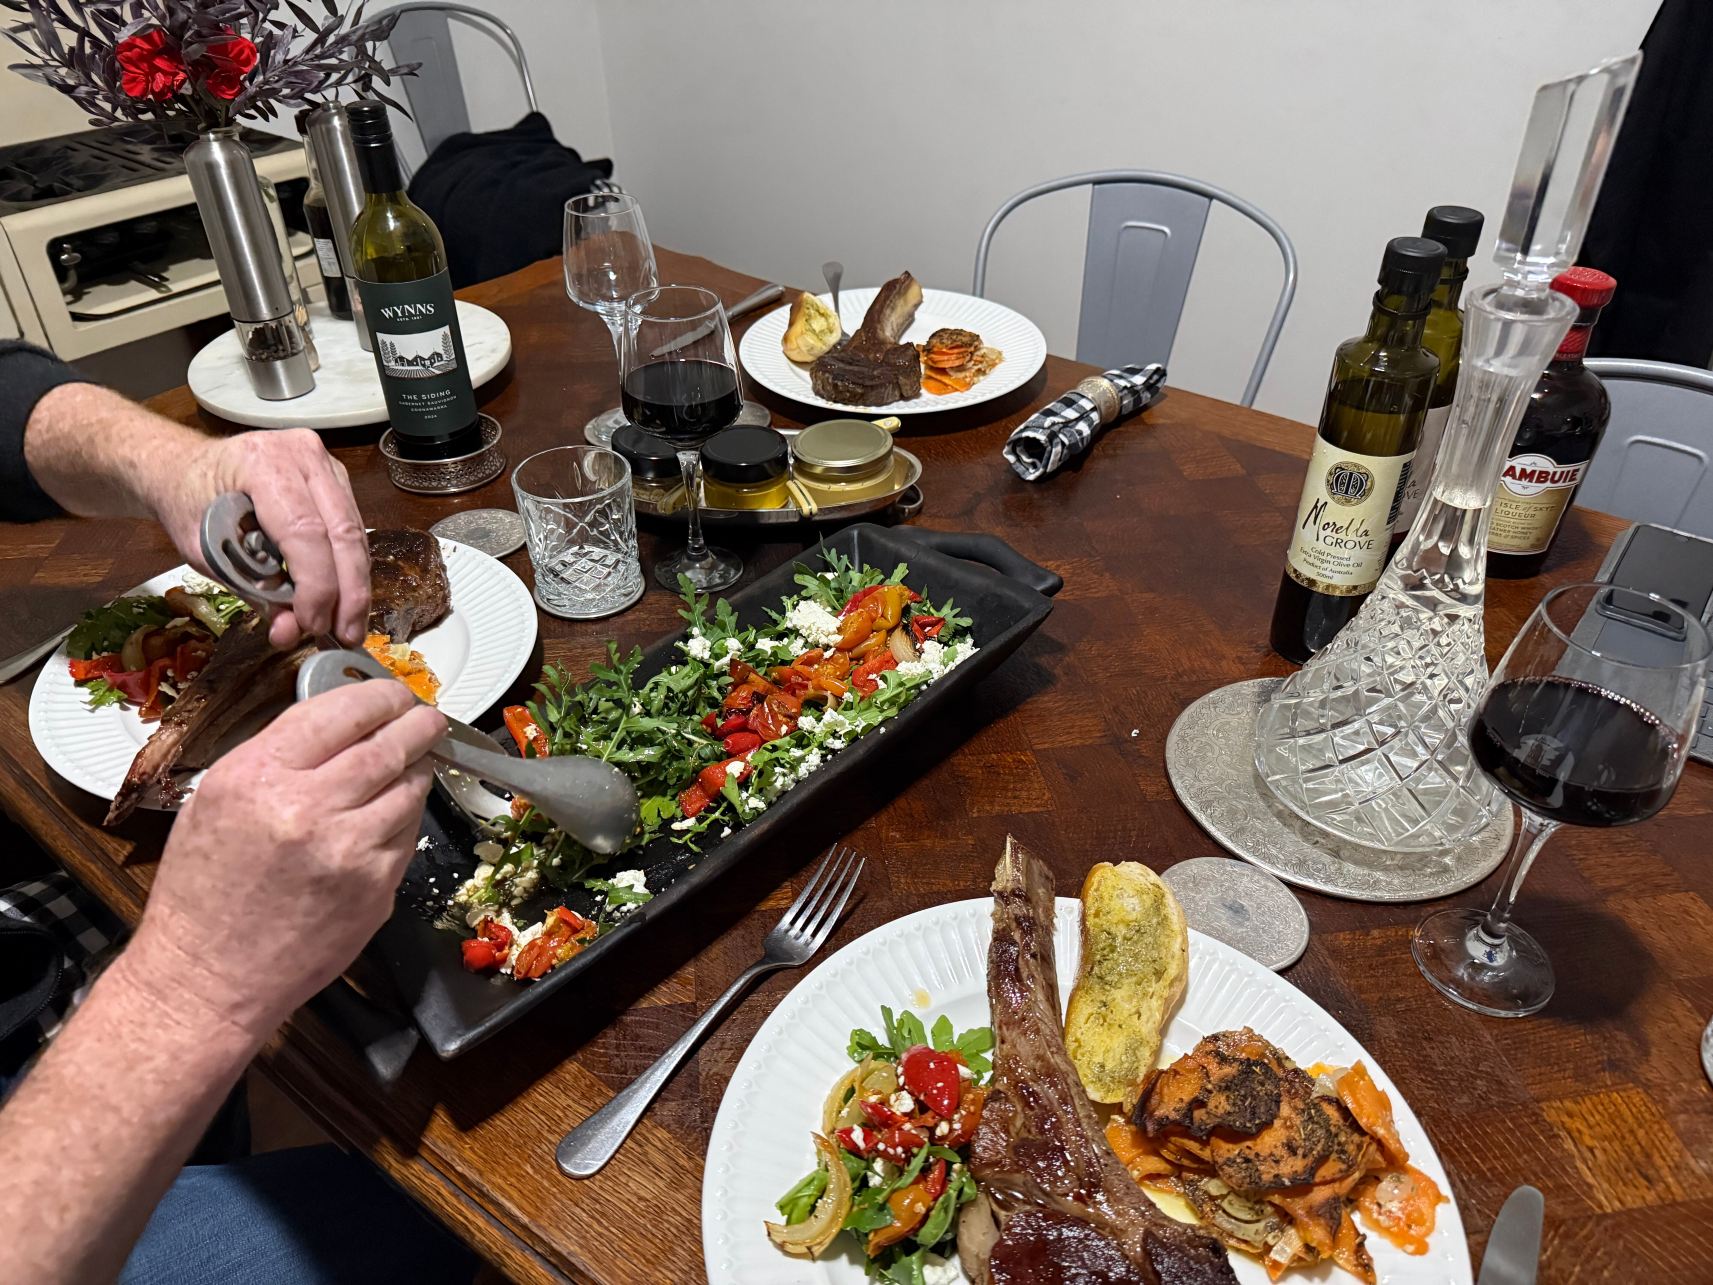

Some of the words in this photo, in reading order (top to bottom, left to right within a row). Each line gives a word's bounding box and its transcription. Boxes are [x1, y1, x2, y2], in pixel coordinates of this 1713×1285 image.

[380, 303, 435, 319] WYNNS
[421, 389, 451, 400] SIDING
[1502, 465, 1580, 484] AMBUIE
[1495, 507, 1536, 519] LIQUEUR
[1500, 501, 1521, 510] ISLE
[1302, 497, 1370, 542] Morella
[1323, 535, 1375, 551] GROVE
[1311, 546, 1325, 556] Cold
[1326, 552, 1351, 562] Pressed
[1313, 554, 1331, 565] Virgin
[1332, 560, 1351, 568] Olive
